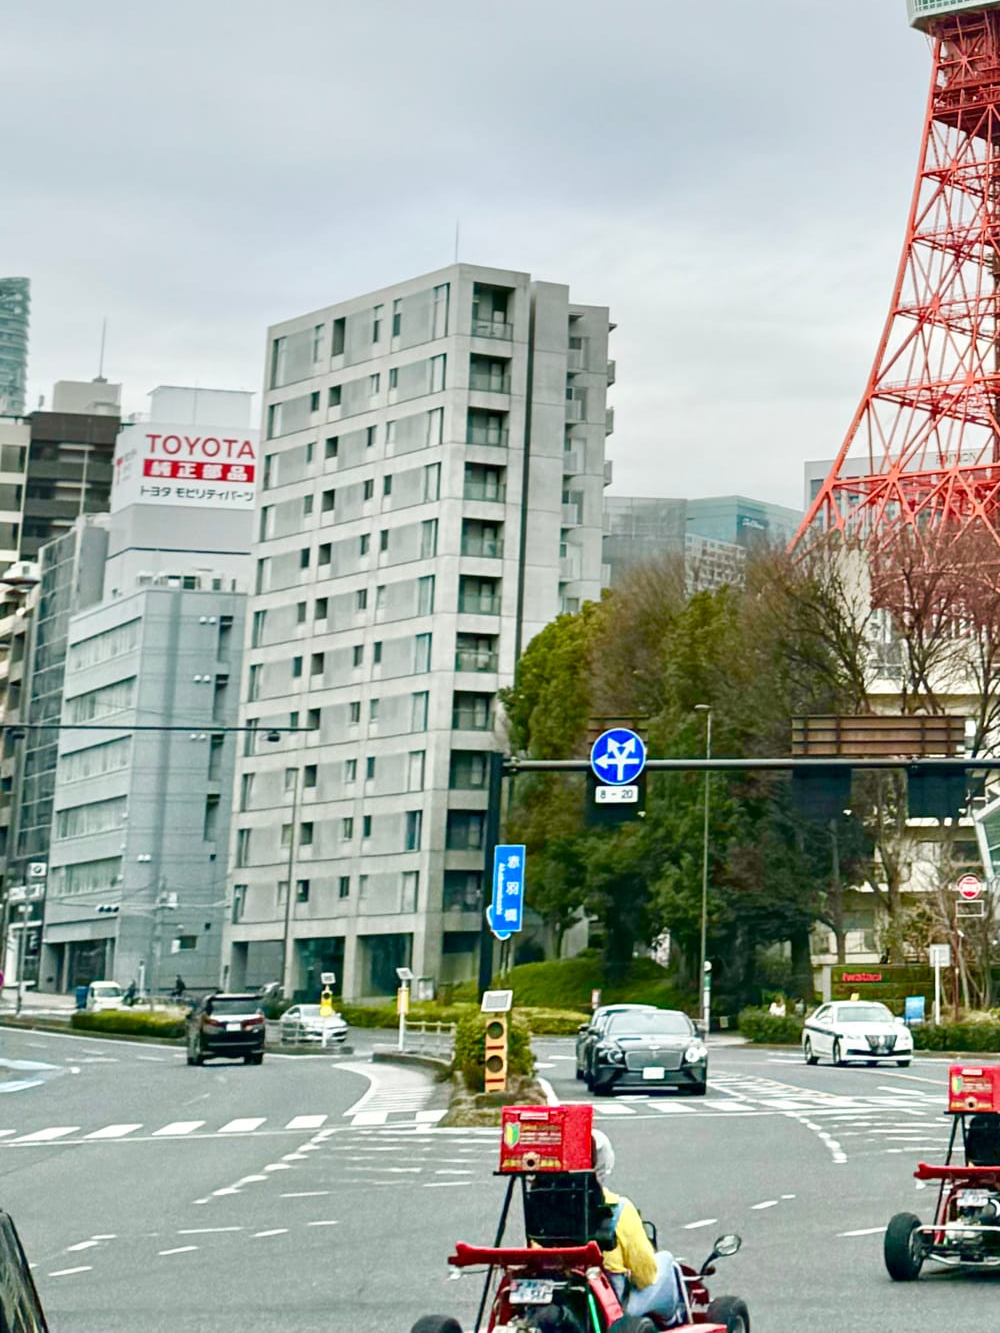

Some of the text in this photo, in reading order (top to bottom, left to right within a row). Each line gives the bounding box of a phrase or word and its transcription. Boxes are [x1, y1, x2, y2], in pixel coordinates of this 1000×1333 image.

[145, 434, 256, 459] TOYOTA
[140, 485, 171, 497] トヨタ
